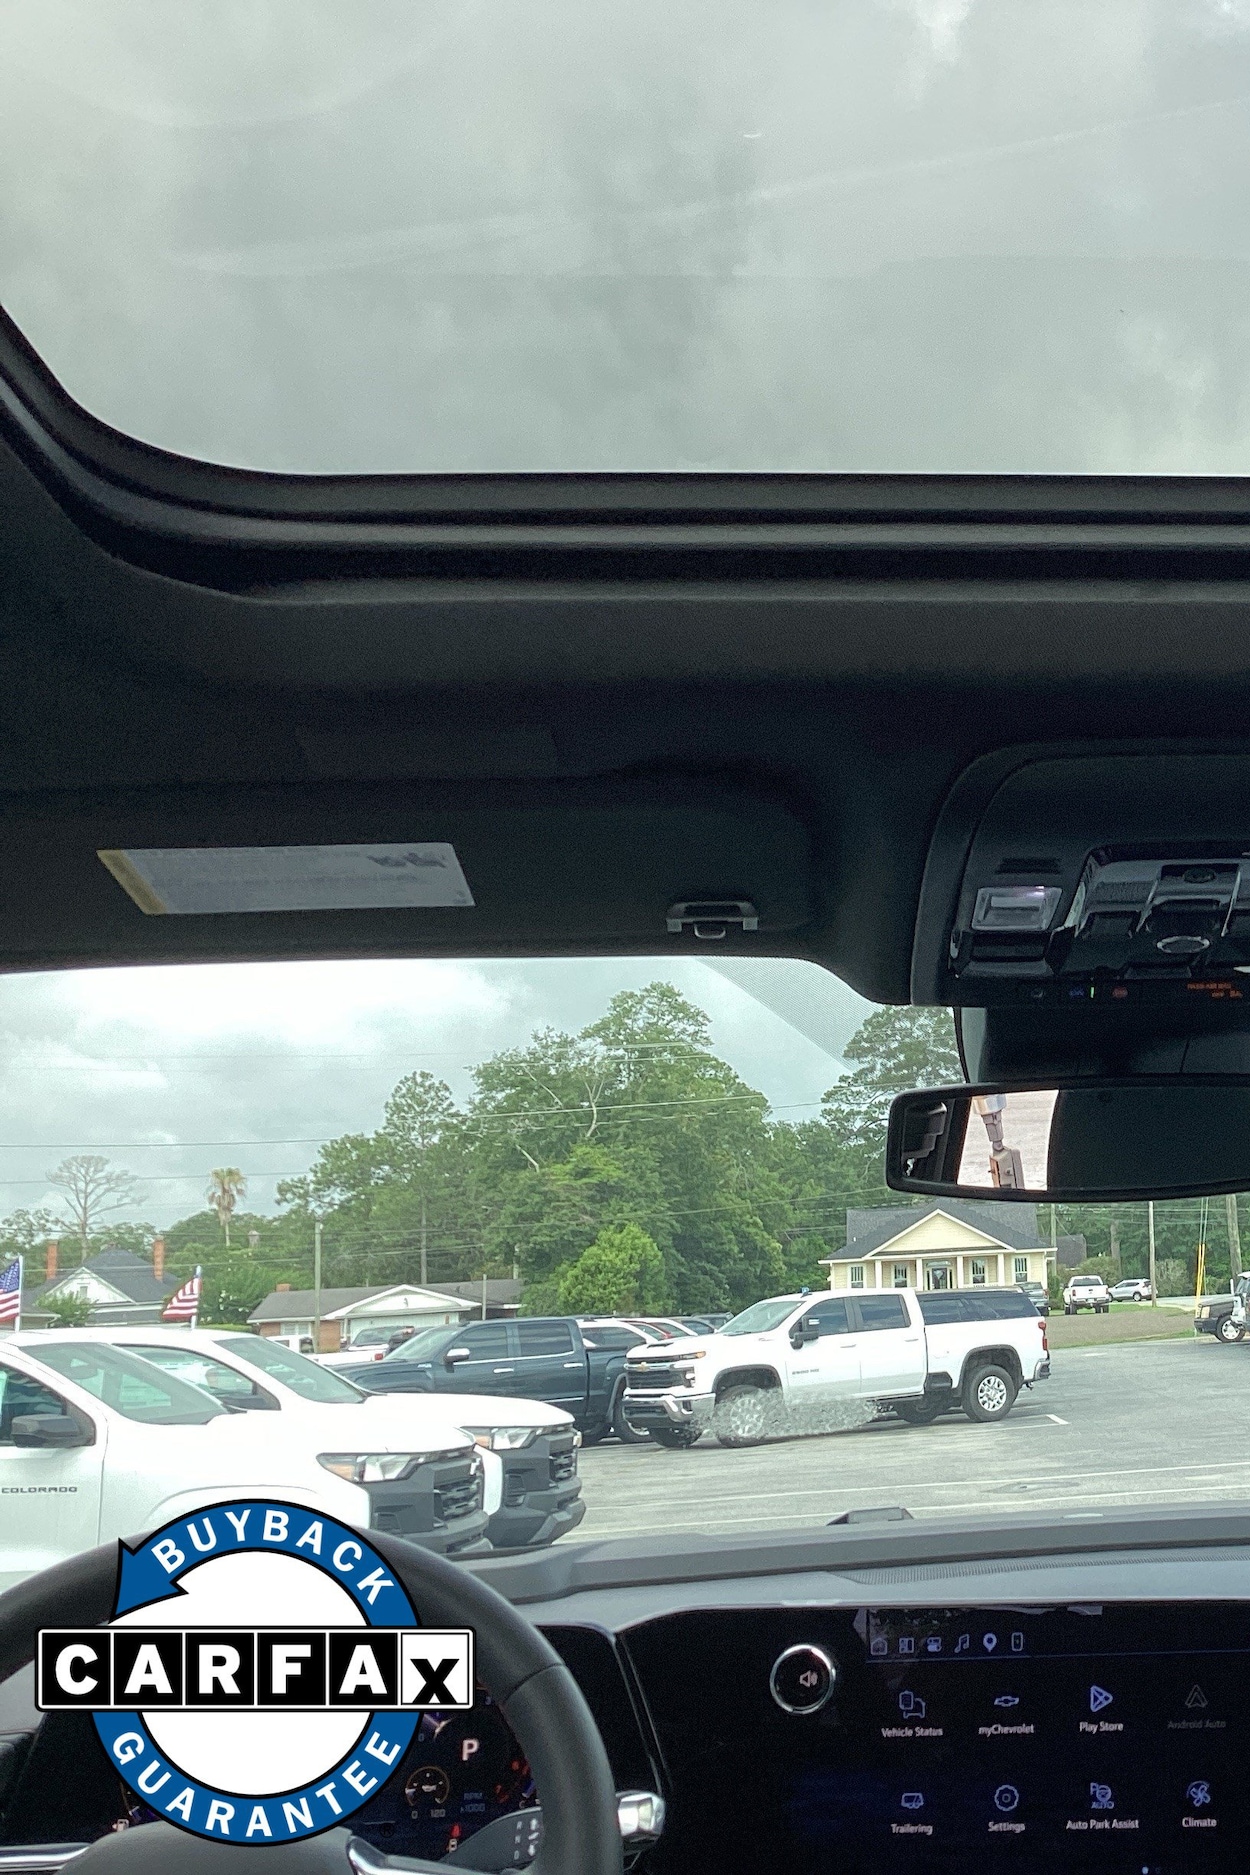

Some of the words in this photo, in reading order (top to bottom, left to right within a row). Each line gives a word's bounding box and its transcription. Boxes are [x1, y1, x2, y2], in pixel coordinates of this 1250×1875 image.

[1, 1486, 78, 1494] COLORADO
[881, 1727, 914, 1738] Vehicle
[914, 1726, 943, 1737] Status
[978, 1723, 1034, 1736] myChevrolet
[1079, 1721, 1099, 1734] Play
[1099, 1721, 1124, 1732] Store
[462, 1738, 479, 1761] P
[988, 1821, 1026, 1833] Settings
[1066, 1819, 1088, 1829] Auto
[1089, 1819, 1111, 1829] Park
[1111, 1818, 1139, 1829] Assist
[1182, 1816, 1217, 1827] Climate
[890, 1823, 933, 1835] Trailering
